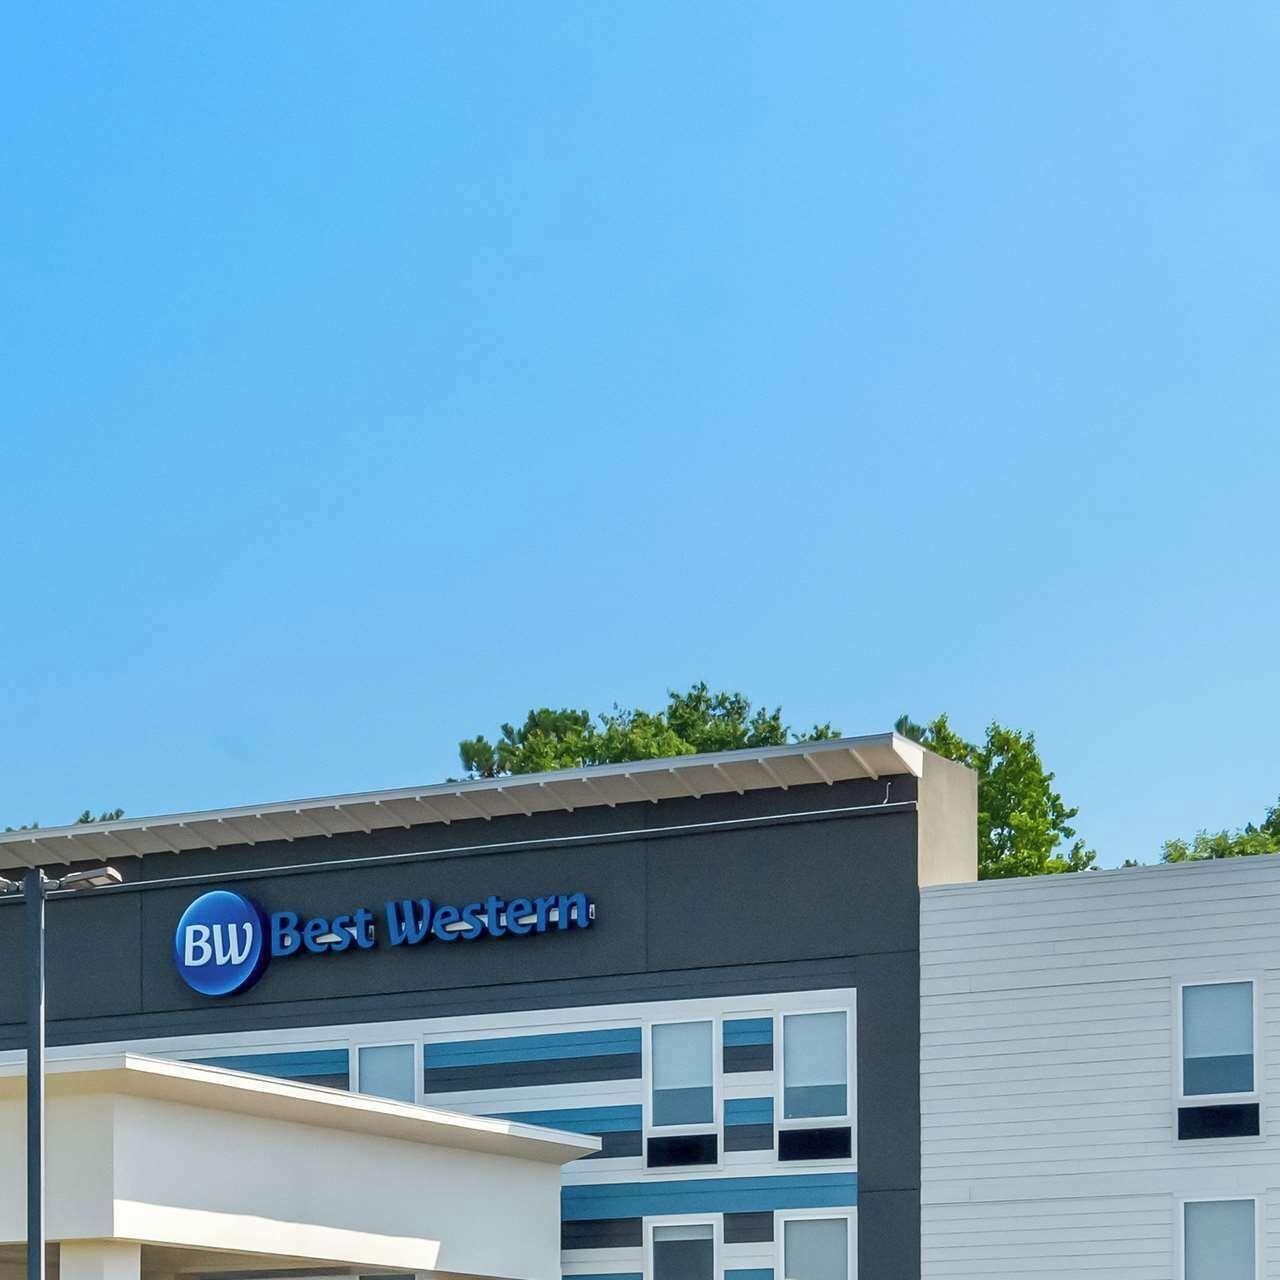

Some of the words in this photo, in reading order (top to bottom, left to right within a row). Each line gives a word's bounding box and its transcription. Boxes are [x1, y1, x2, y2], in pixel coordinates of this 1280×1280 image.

[184, 922, 254, 967] BW
[272, 907, 375, 956] Best
[385, 892, 591, 946] Western
